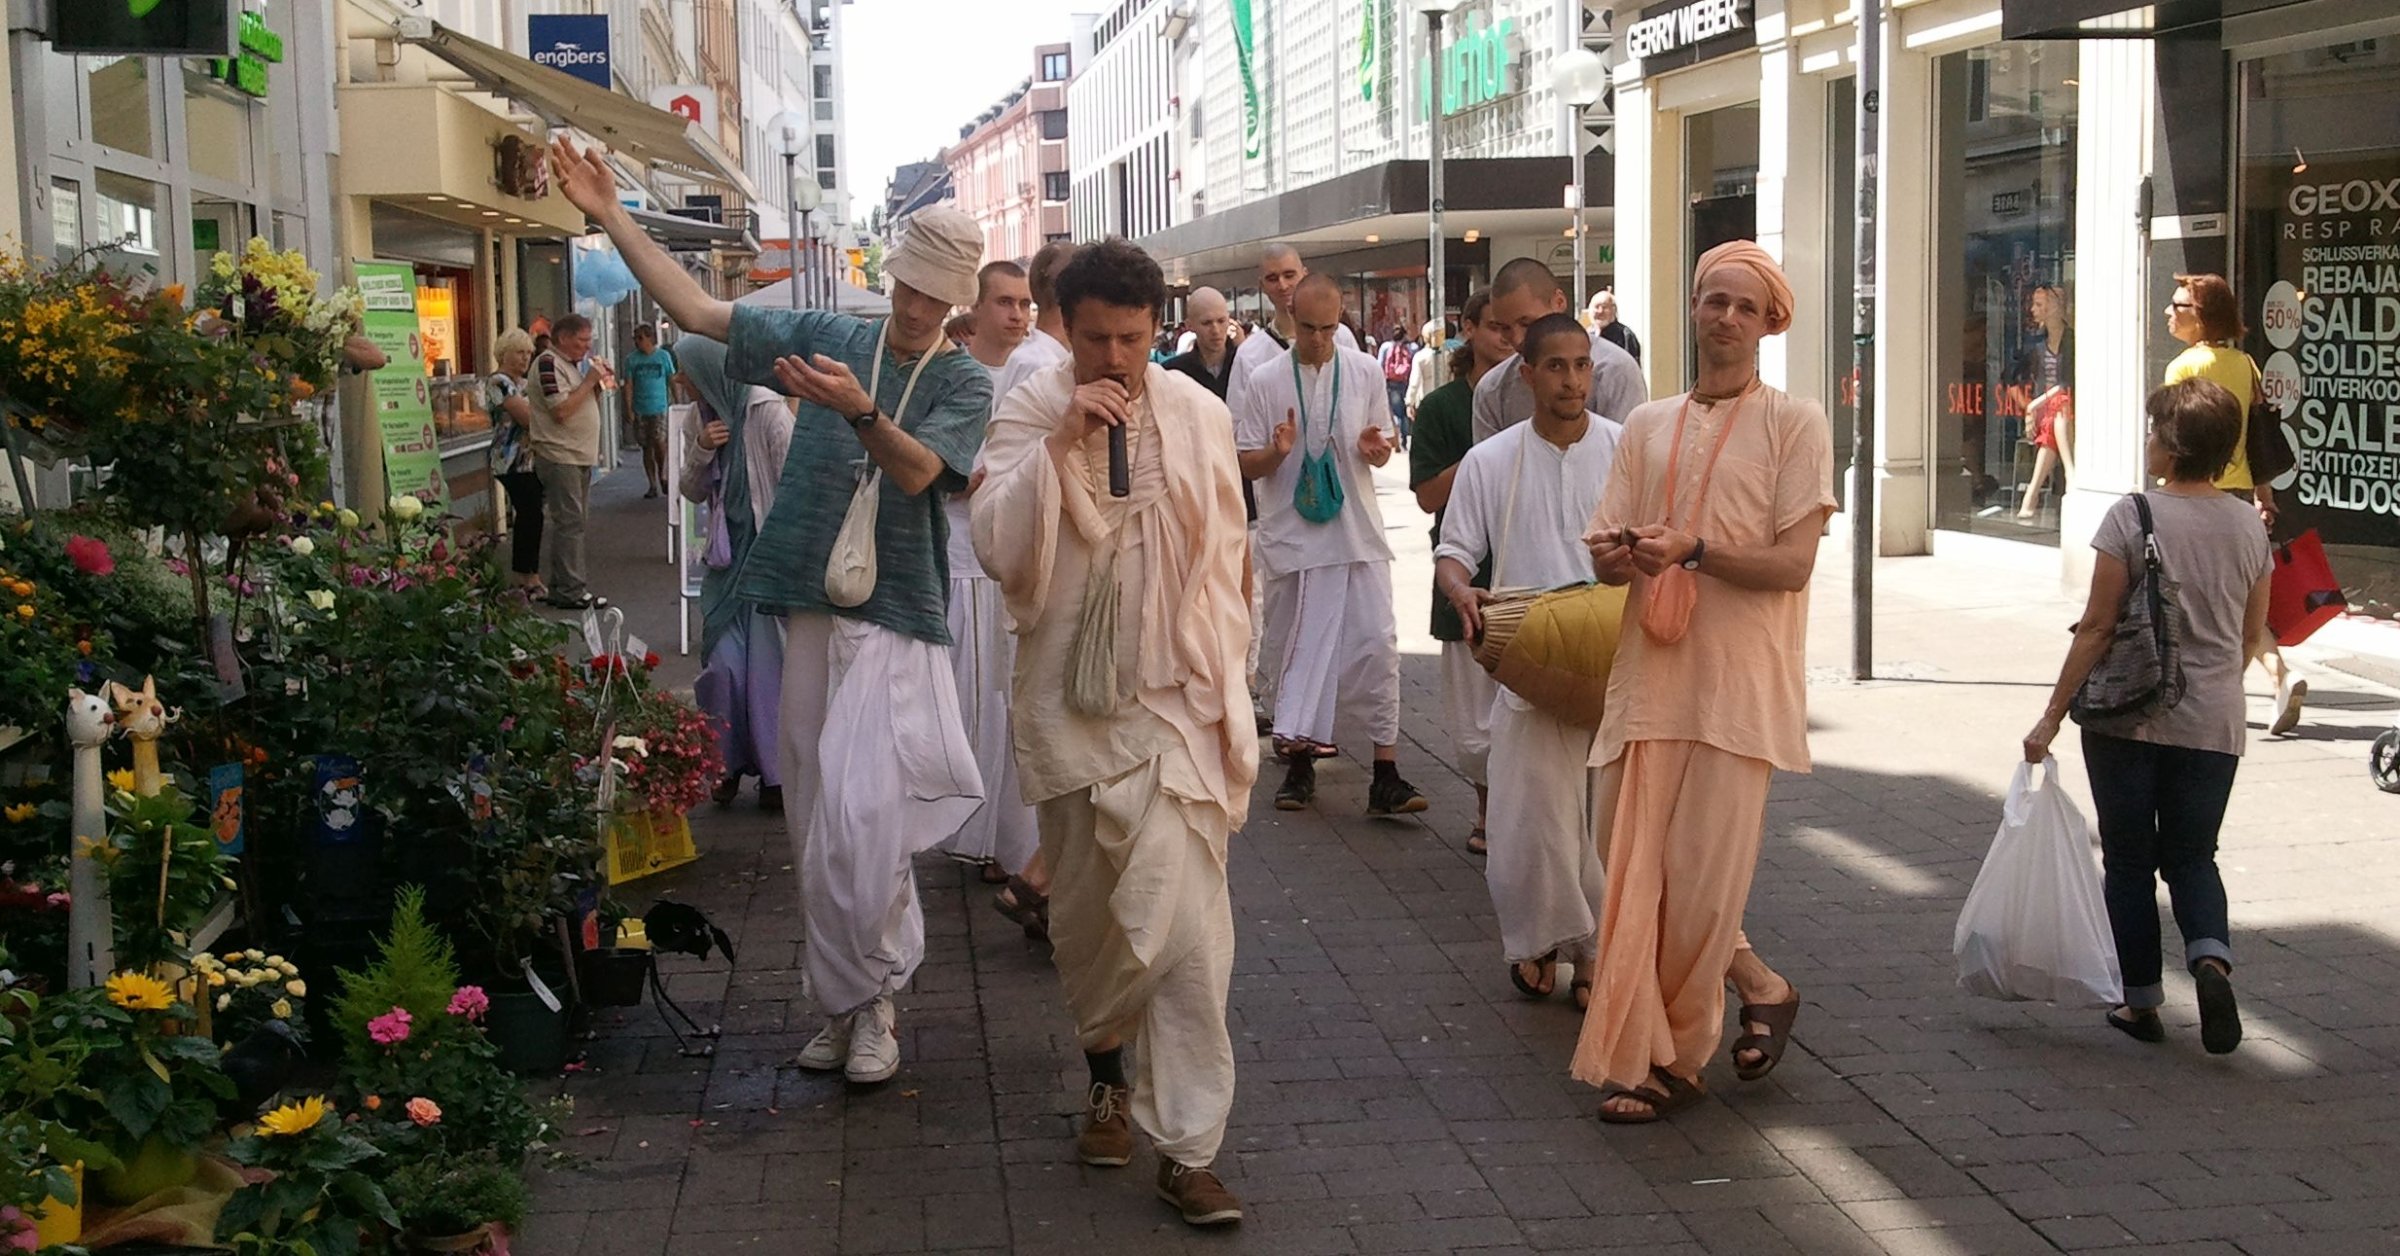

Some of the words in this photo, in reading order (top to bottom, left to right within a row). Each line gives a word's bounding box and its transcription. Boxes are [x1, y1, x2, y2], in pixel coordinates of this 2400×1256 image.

[1626, 9, 1677, 60] GERRY
[1678, 0, 1739, 45] WEBER
[534, 49, 607, 68] engbers
[2288, 178, 2400, 216] GEOX
[2303, 265, 2400, 294] REBAJA
[2302, 297, 2400, 341] SALD
[1949, 384, 1983, 415] SALE
[2302, 376, 2400, 402] UITVERKOO
[2301, 399, 2400, 453] SALE
[2299, 449, 2400, 480] ΕΚΠΤΩΣΕΙ
